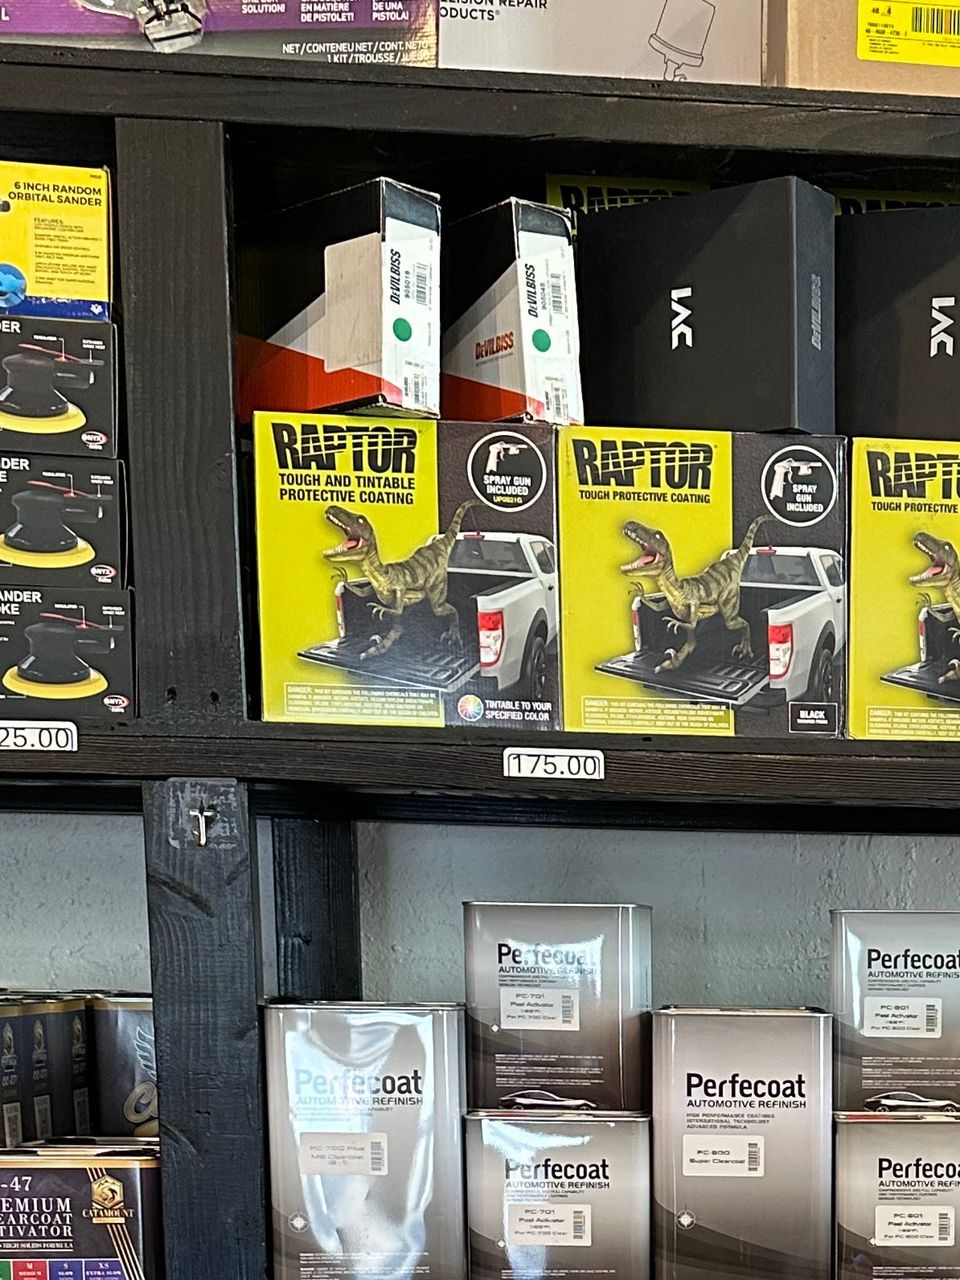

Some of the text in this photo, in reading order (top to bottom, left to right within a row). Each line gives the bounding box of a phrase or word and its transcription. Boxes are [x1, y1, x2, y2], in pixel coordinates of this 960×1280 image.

[242, 3, 285, 13] SOLUTION!
[313, 2, 349, 11] MATIÈRE
[373, 2, 403, 10] DE UNA
[301, 12, 354, 21] DE PISTOLET!
[14, 182, 102, 195] 6 INCH RANDOM
[8, 192, 102, 207] ORBITAL SANDER
[271, 422, 417, 474] RAPTOR
[572, 439, 713, 489] RAPTOR
[279, 473, 415, 490] TOUGH AND TINTABLE
[484, 475, 531, 486] SPRAY GUN
[486, 485, 528, 495] INCLUDED
[792, 484, 817, 493] SPRAY
[280, 489, 414, 505] PROTECTIVE COATING
[579, 490, 710, 503] TOUGH PROTECTIVE COATING
[796, 494, 812, 502] GUN
[786, 502, 823, 512] INCLUDED
[486, 700, 552, 711] TINTABLE TO YOUR
[486, 710, 549, 721] SPECIFIED COLOR
[800, 710, 825, 719] BLACK
[513, 755, 597, 775] 175.00
[687, 1073, 806, 1098] Perfecoat
[687, 1100, 806, 1108] AUTOMOTIVE REFINISH
[82, 1209, 134, 1218] CATAMOUNT
